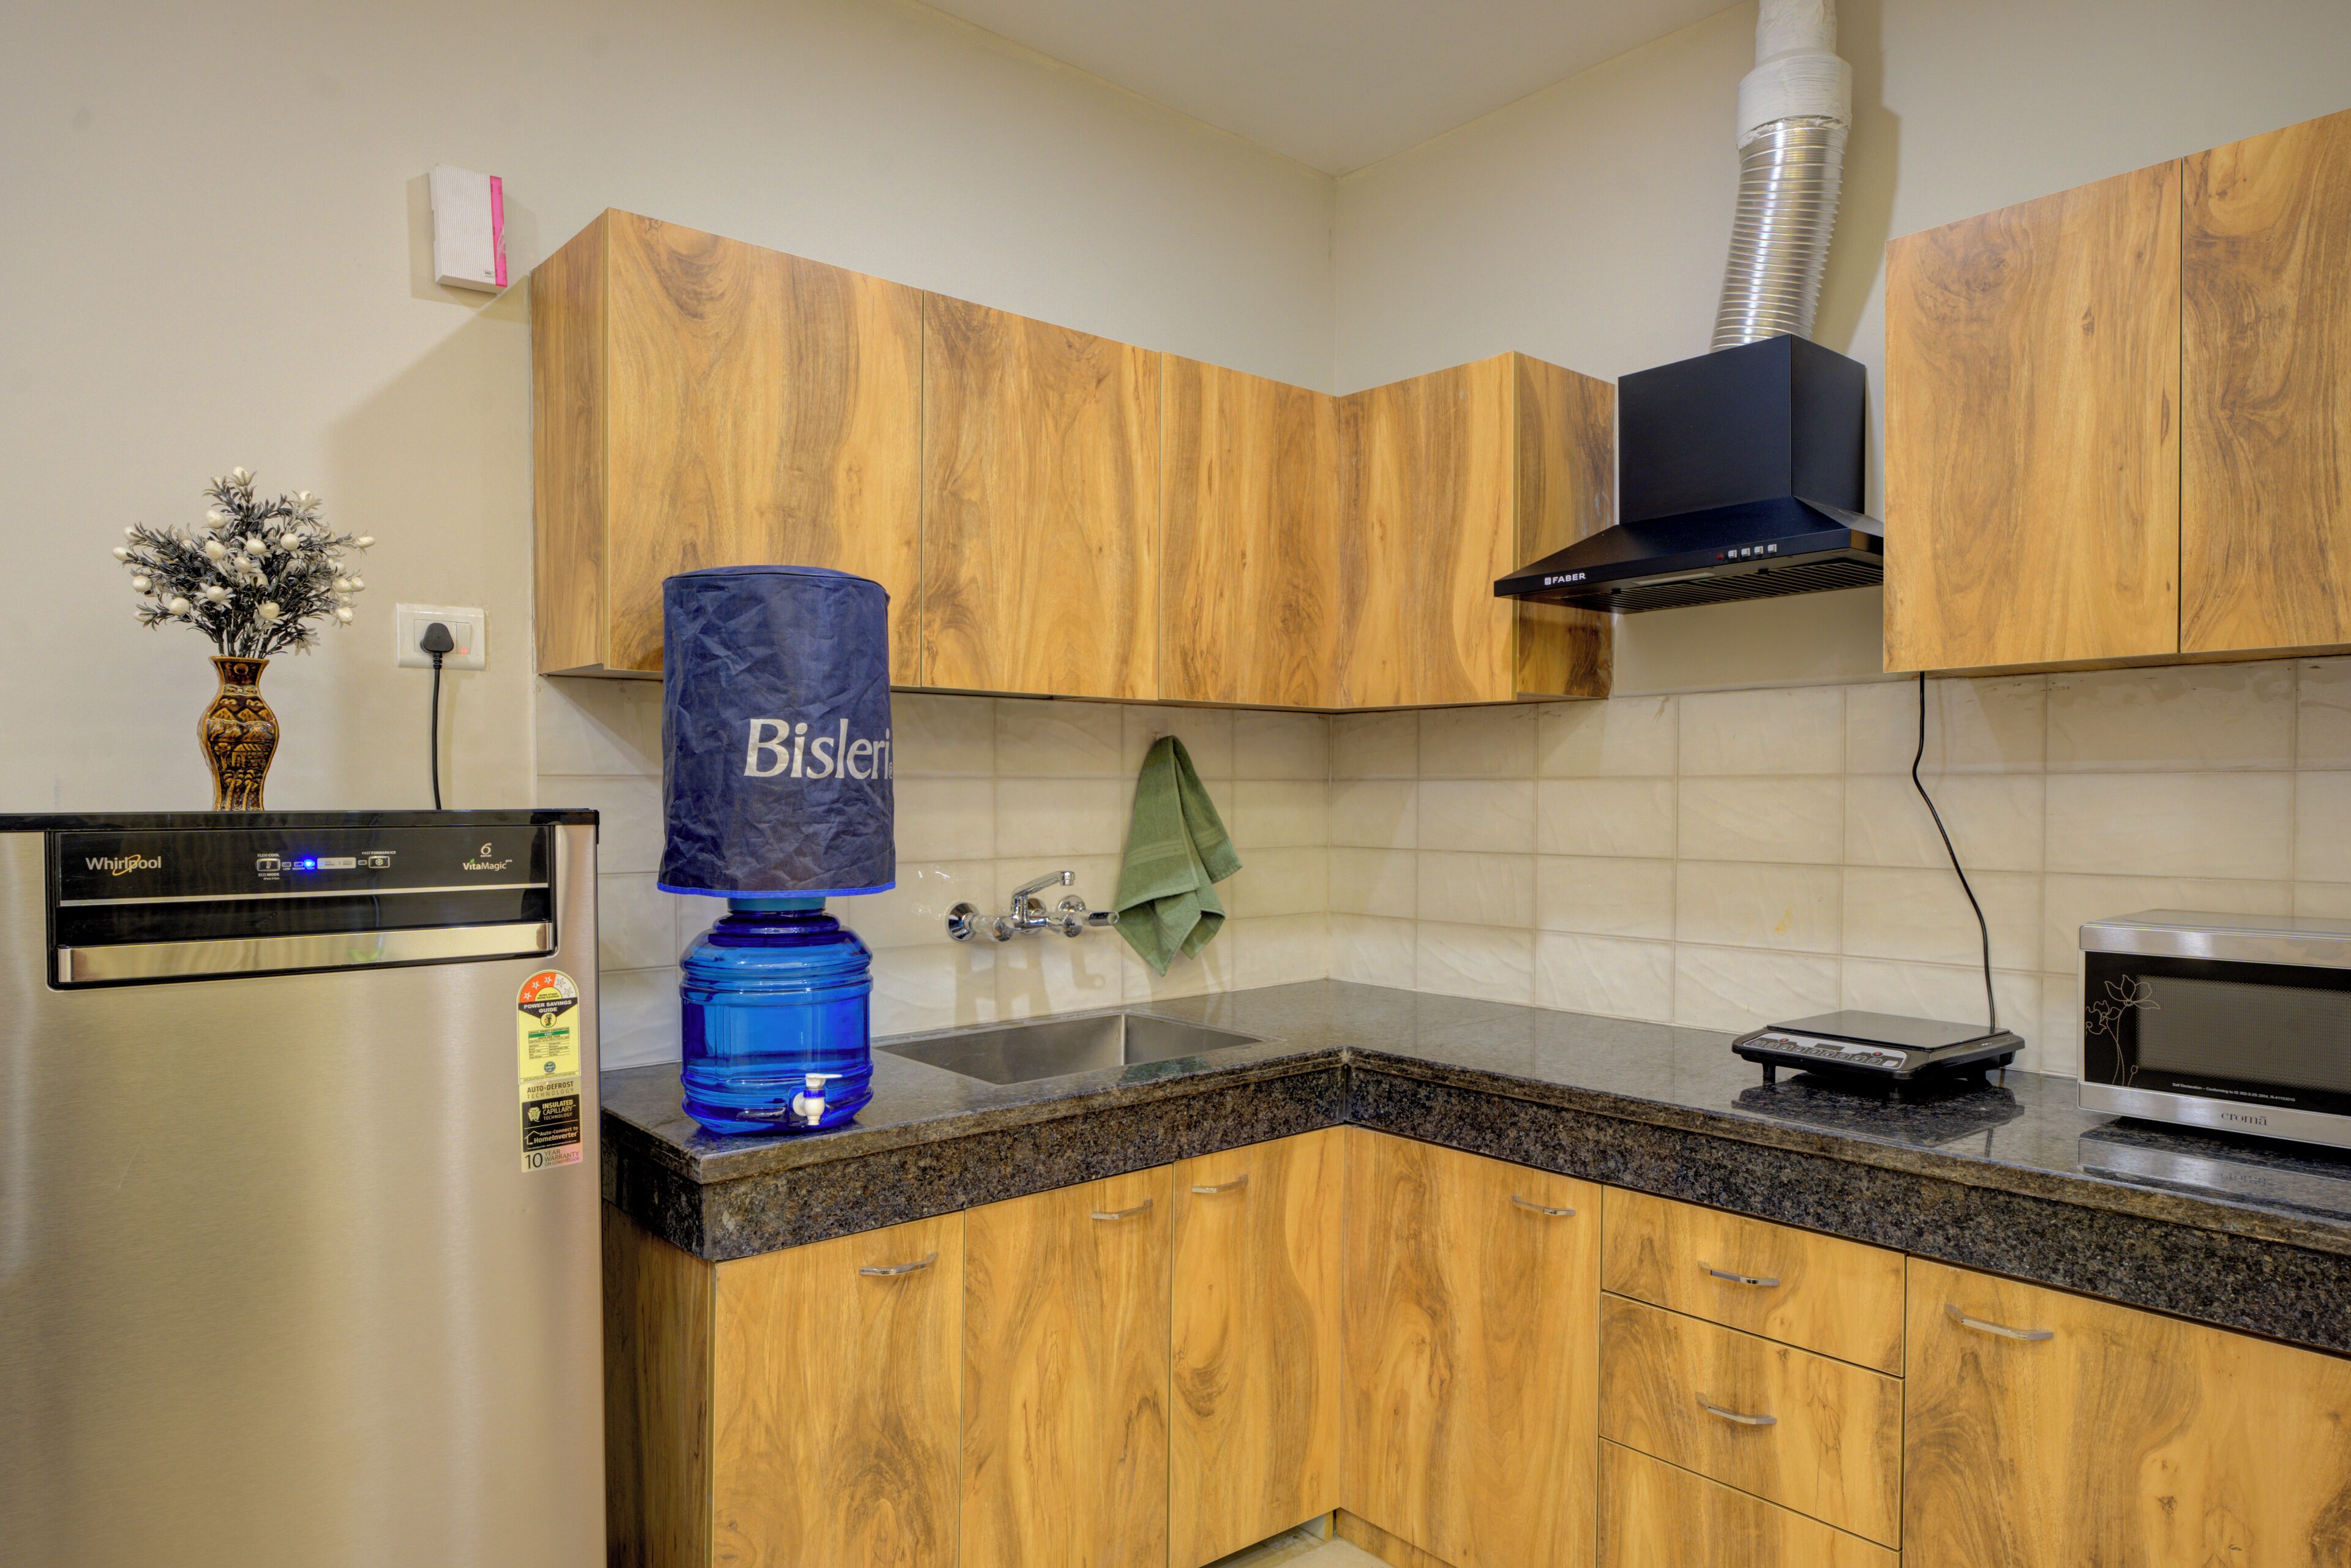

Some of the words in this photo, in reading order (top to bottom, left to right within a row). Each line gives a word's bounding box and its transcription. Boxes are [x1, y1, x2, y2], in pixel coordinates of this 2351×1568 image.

[1553, 572, 1586, 584] FABER
[85, 855, 162, 873] Whirlpool
[462, 861, 507, 871] VitaMagic
[527, 1081, 574, 1093] AUTO-DEFROST
[527, 1087, 574, 1100] TECHNOLOGY
[542, 1099, 574, 1109] INSULATED
[544, 1112, 573, 1121] TECHNOLOGY
[539, 1127, 572, 1136] Auto-Connect
[525, 1152, 543, 1169] 10
[544, 1150, 580, 1163] WARRANTY
[552, 1157, 580, 1166] COMPRESSOR
